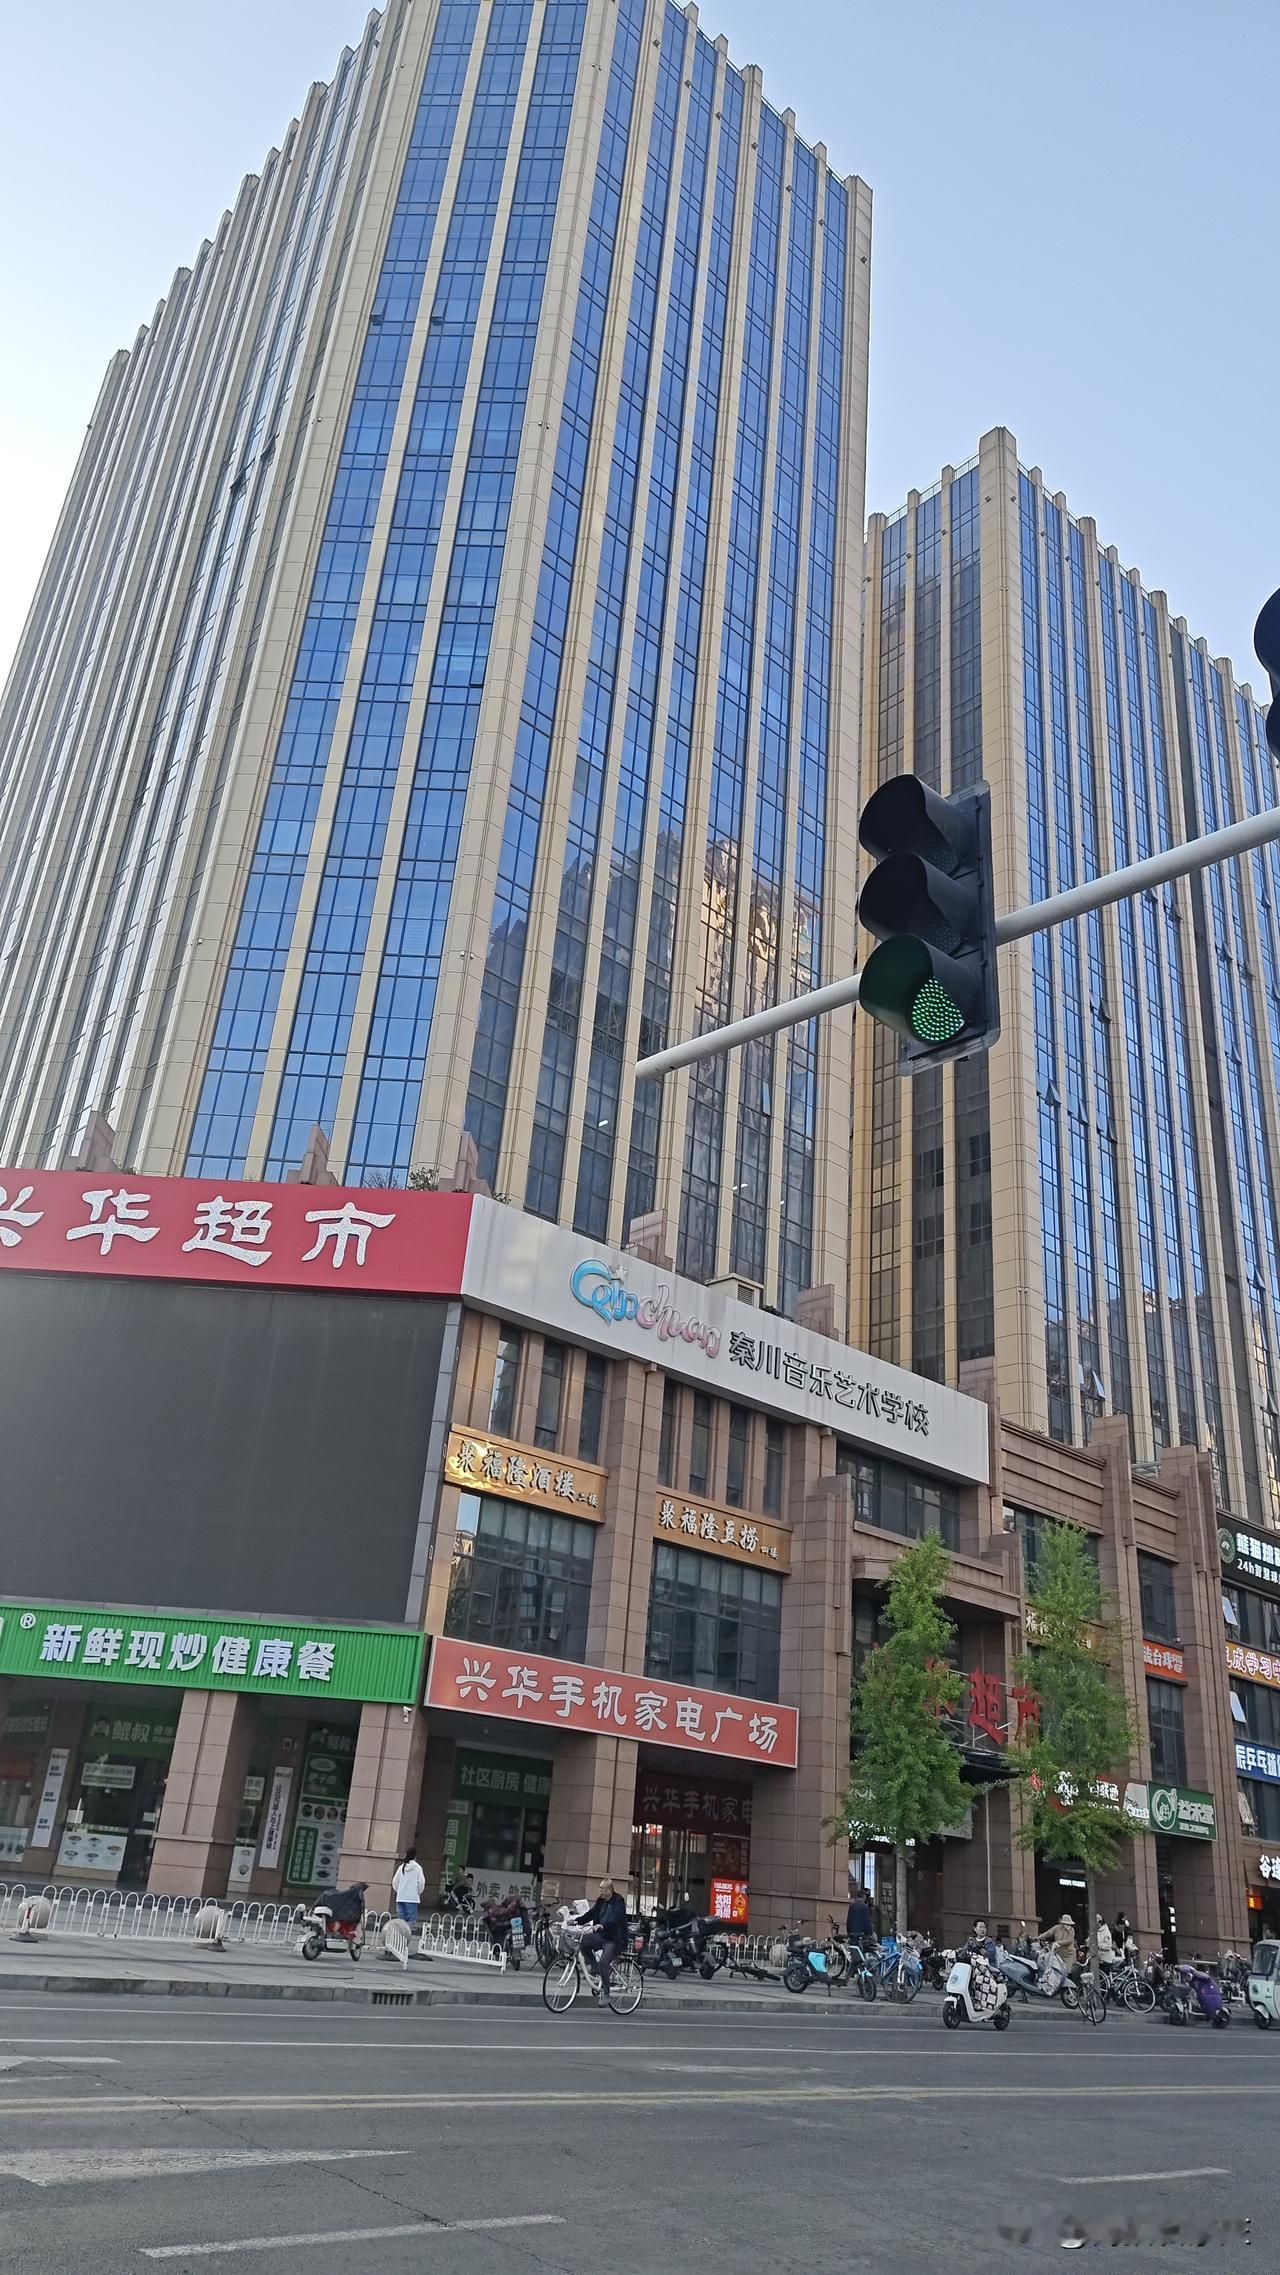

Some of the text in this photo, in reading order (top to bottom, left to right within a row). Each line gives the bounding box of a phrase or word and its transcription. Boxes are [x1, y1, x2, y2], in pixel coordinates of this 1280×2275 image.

[728, 1331, 930, 1436] 秦川音乐艺术学校
[457, 1440, 576, 1502] 聚福隆酒楼
[660, 1500, 759, 1553] 聚福隆豆捞
[1237, 1558, 1280, 1586] 24h智慧球
[39, 1623, 336, 1682] 新鲜现炒健康餐
[455, 1656, 780, 1754] 兴华手机家电广场
[462, 1765, 520, 1792] 社区厨房
